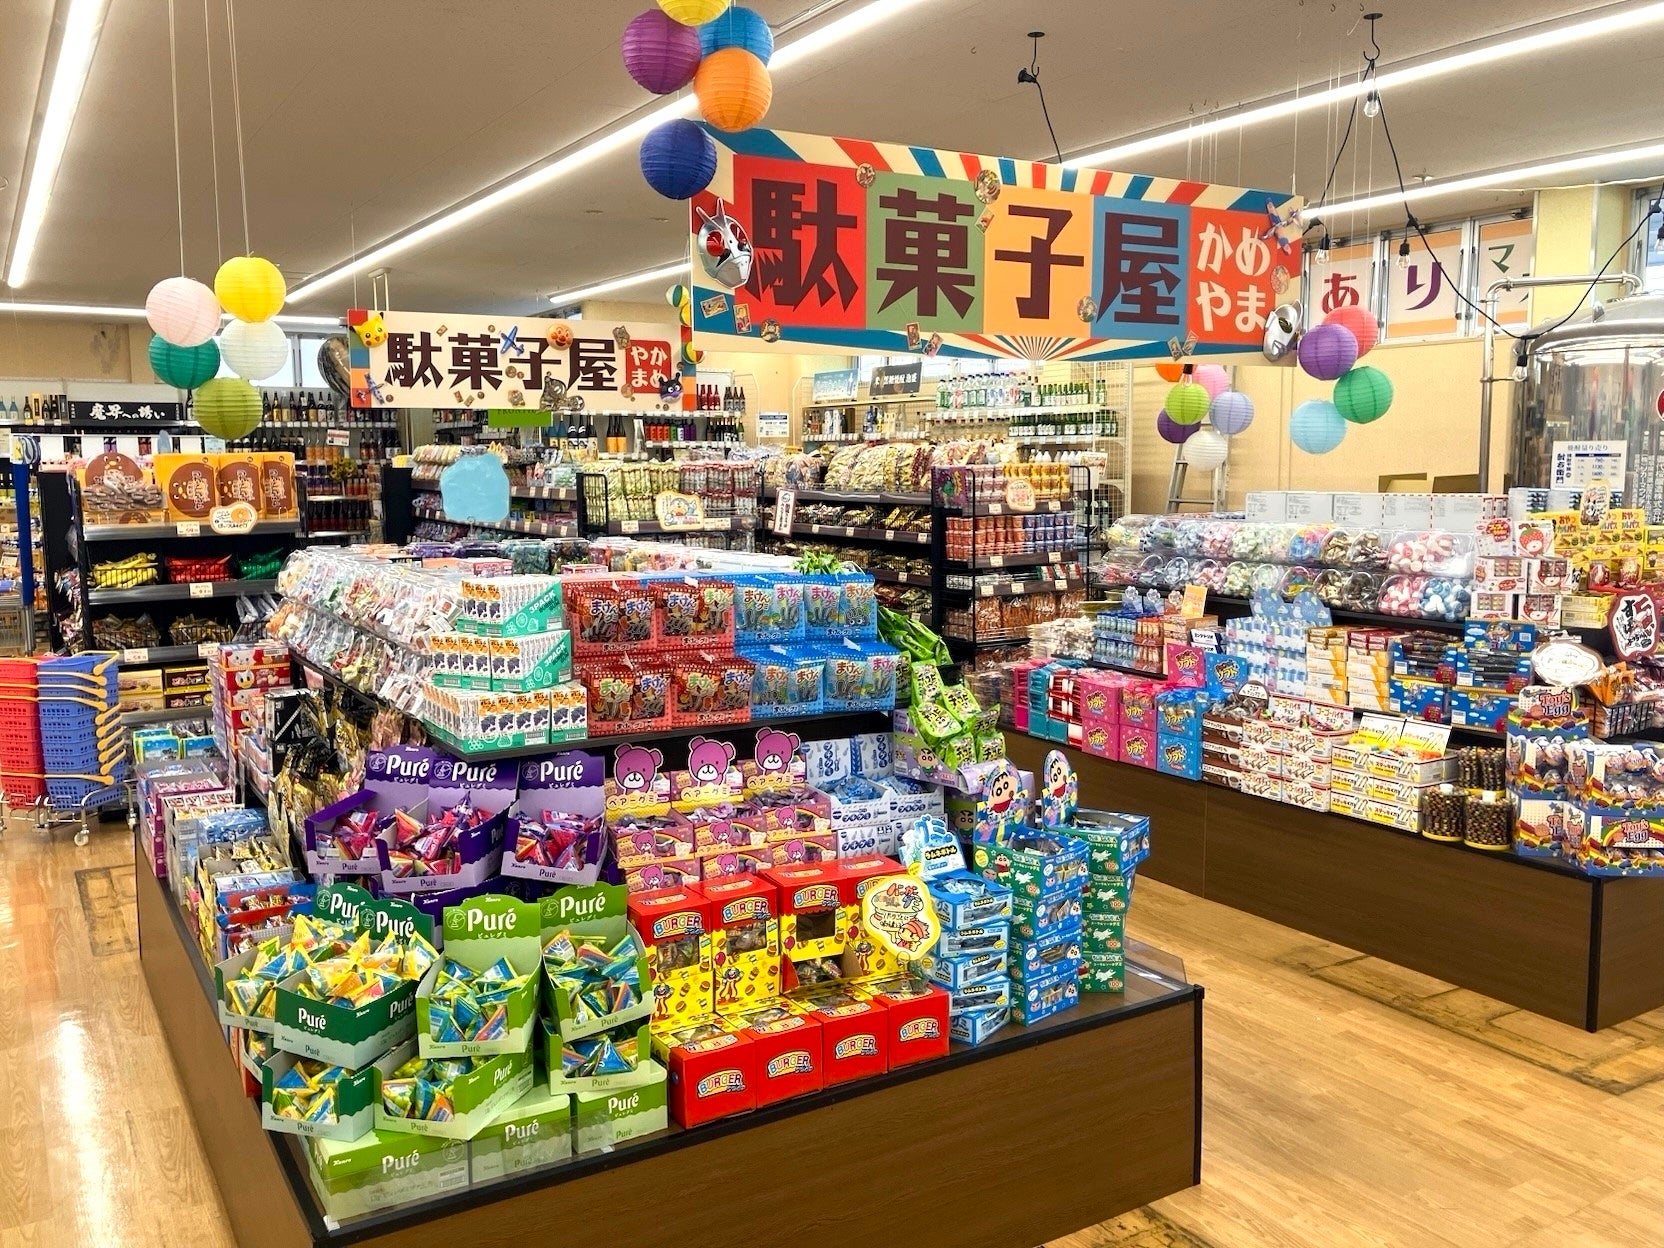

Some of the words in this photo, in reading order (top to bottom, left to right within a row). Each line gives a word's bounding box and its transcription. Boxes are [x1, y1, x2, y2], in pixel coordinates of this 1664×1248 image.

[744, 179, 1181, 325] 駄菓子屋
[1197, 222, 1271, 276] かめ
[1322, 273, 1359, 315] あ
[1405, 261, 1441, 310] り
[1196, 281, 1266, 332] やま
[384, 331, 617, 391] 駄菓子屋
[529, 590, 556, 614] 3PACK
[1540, 691, 1571, 706] Toy's
[1544, 704, 1571, 717] Egg
[386, 754, 430, 778] Puré
[451, 761, 497, 782] Puré
[540, 760, 584, 782] Puré
[749, 776, 791, 787] ベアーグミ
[609, 795, 655, 806] ベアーグミ
[683, 786, 731, 798] ベアーグミ
[1626, 831, 1649, 843] Egg
[925, 846, 957, 860] ラムネボトル
[342, 862, 358, 872] Puré
[539, 868, 556, 879] Puré
[420, 879, 437, 887] Puré
[330, 893, 366, 918] Pur
[560, 892, 606, 918] Puré
[796, 888, 838, 905] BURGER
[467, 908, 516, 931] Puré
[724, 900, 768, 920] BURGER
[376, 911, 414, 938] Puré
[655, 915, 703, 937] BURGER
[298, 1008, 327, 1030] Puré
[600, 1016, 619, 1027] Puré
[901, 1022, 939, 1040] BURGER
[305, 1045, 320, 1057] Puré
[461, 1044, 480, 1053] Puré
[836, 1039, 875, 1057] BURGER
[493, 1059, 513, 1086] Puré
[768, 1056, 810, 1076] BURGER
[591, 1078, 610, 1088] Puré
[699, 1074, 743, 1096] BURGER
[607, 1093, 640, 1114] Puré
[297, 1122, 314, 1133] Puré
[411, 1122, 428, 1132] Puré
[504, 1119, 540, 1142] Puré
[615, 1128, 633, 1139] Puré
[382, 1149, 420, 1174] Puré
